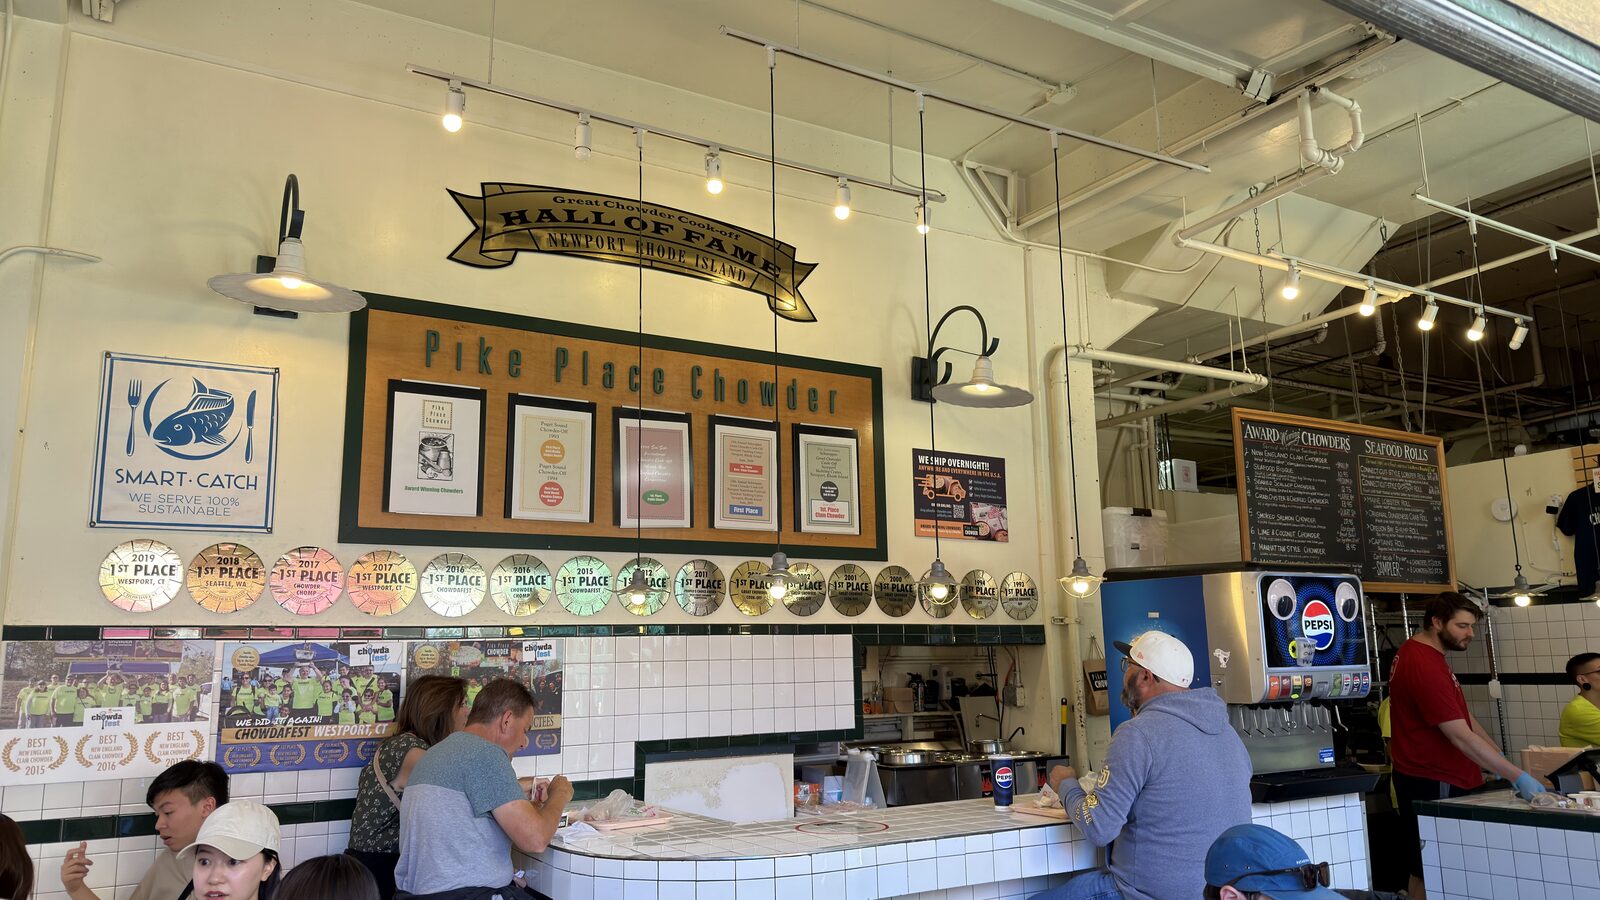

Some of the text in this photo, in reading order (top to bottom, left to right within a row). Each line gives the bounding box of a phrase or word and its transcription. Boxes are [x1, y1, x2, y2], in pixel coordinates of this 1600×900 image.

[552, 195, 741, 241] Great Chowder Cook-off
[498, 208, 782, 278] HALL OF FAME
[548, 232, 746, 282] NEWPORT RHODE ISLAND
[425, 329, 837, 414] Pike Place Chowder
[1244, 424, 1280, 443] AWARD
[1301, 431, 1351, 454] CHOWDERS
[1365, 439, 1429, 462] SEAFOOD ROLLS
[1264, 450, 1288, 459] ENGLAND
[1304, 455, 1328, 464] CHOWDER
[918, 455, 990, 471] WE SHIP OVERNIGHT!!!
[950, 468, 977, 476] EVERYWHERE
[420, 486, 440, 494] Winning
[440, 487, 464, 495] Chowders
[129, 493, 240, 507] WE SERVE 100%
[138, 504, 231, 517] SUSTAINABLE
[1257, 528, 1270, 536] LIME
[1297, 530, 1320, 539] CHOWDER
[1286, 545, 1301, 553] STYLE
[1303, 546, 1326, 555] CHOWDER
[131, 553, 155, 563] 2019
[216, 556, 240, 566] 2018
[298, 560, 320, 569] 2017
[372, 563, 393, 571] 2017
[445, 565, 465, 573] 2016
[109, 564, 176, 577] 1ST PLACE
[197, 566, 259, 580] 1ST PLACE
[513, 566, 531, 574] 2016
[694, 570, 708, 578] 2011
[279, 569, 338, 582] 1ST PLACE
[355, 572, 411, 584] 1ST PLACE
[429, 573, 481, 586] 1ST PLACE
[498, 574, 546, 586] 1ST PLACE
[118, 578, 156, 586] WESTPORT,
[205, 580, 235, 588] SEATTLE,
[562, 575, 609, 587] 1ST PLACE
[681, 578, 722, 589] 1ST PLACE
[736, 579, 747, 588] 1ST
[798, 581, 822, 591] PLACE
[834, 581, 869, 591] 1ST PLACE
[880, 583, 913, 592] 1ST PLACE
[965, 585, 996, 596] 1ST PLACE
[1005, 588, 1035, 597] 1ST PLACE
[1304, 619, 1332, 630] PEPSI
[357, 646, 389, 656] chowda
[524, 643, 552, 652] chowda
[371, 654, 390, 662] fest
[91, 711, 123, 721] chowda
[236, 716, 323, 727] WE DID IT AGAIN!
[167, 731, 185, 741] BEST
[234, 723, 389, 740] CHOWDAFEST WESTPORT, CT
[27, 738, 47, 748] BEST
[99, 735, 117, 745] BEST
[25, 765, 45, 775] 2015
[97, 761, 116, 771] 2016
